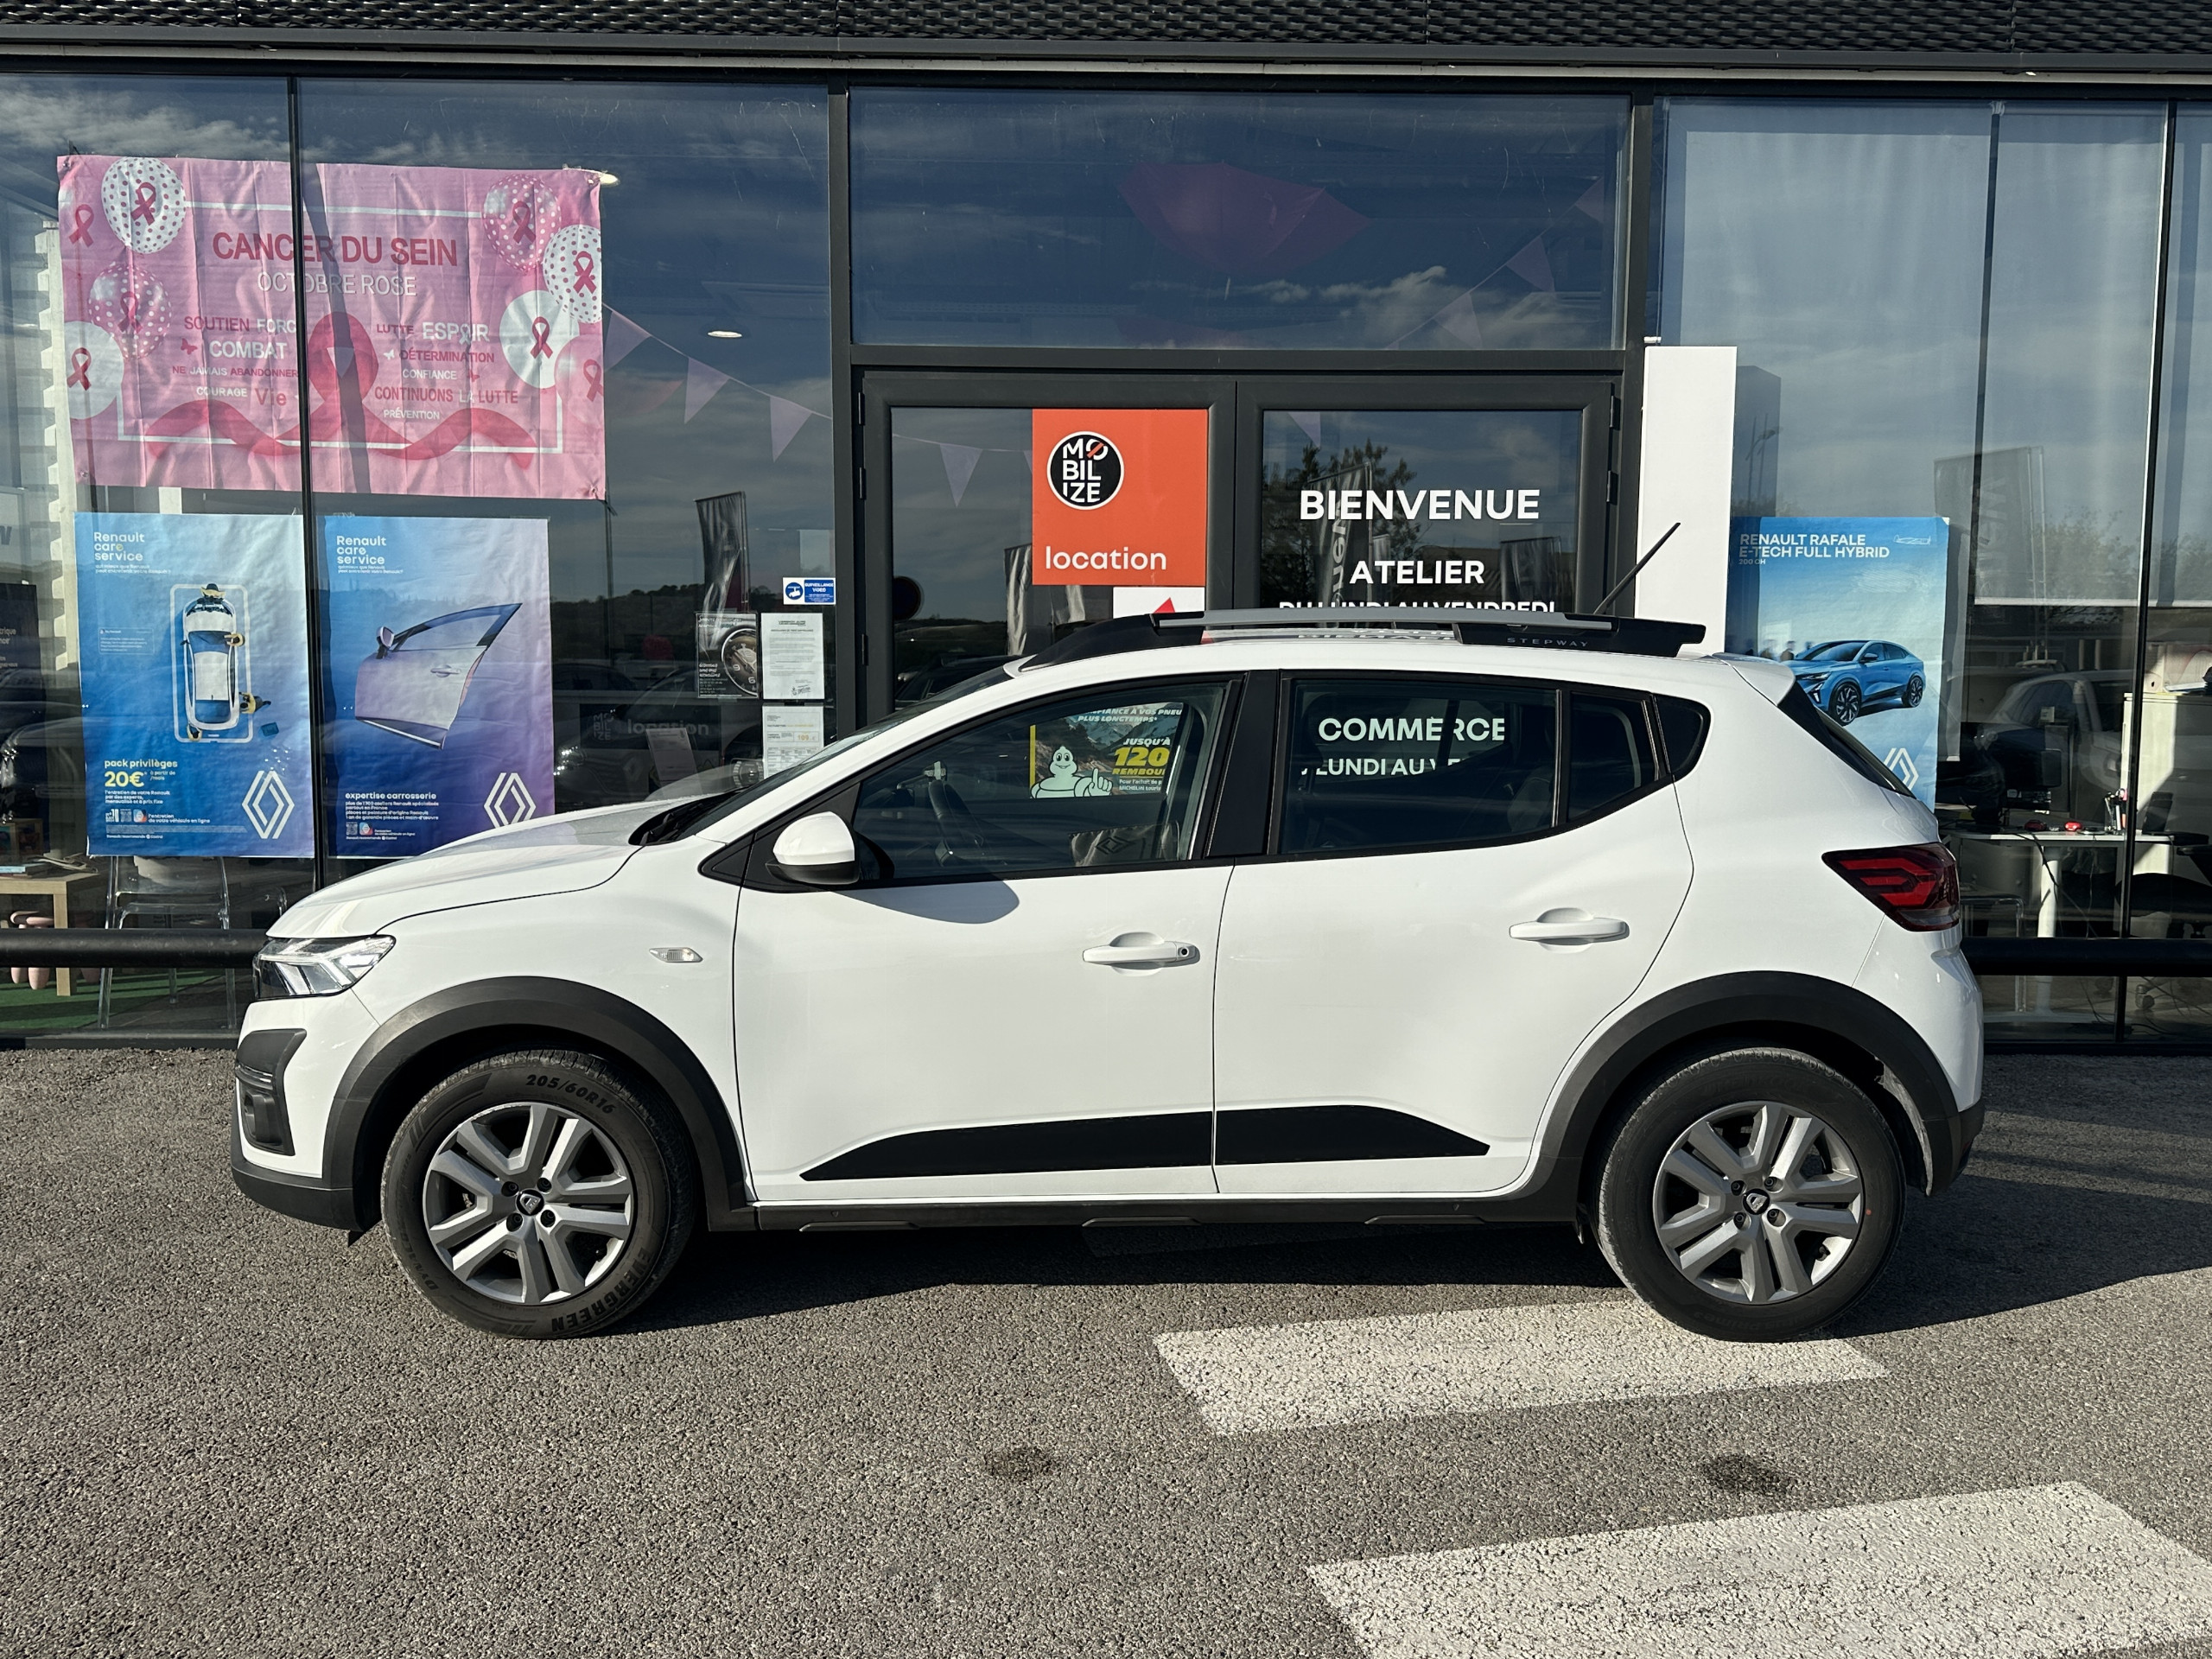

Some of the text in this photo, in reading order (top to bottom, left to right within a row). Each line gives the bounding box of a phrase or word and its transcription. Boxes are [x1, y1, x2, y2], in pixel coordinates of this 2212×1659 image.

[212, 232, 458, 266] CANCER DU SEIN
[257, 271, 416, 296] OCTOBRE ROSE
[184, 316, 296, 334] SOUTIEN FORC
[377, 321, 490, 345] LUTTE ESPOIR
[209, 340, 288, 359] COMBAT
[400, 347, 495, 363] DÉTERMINATION
[172, 365, 299, 378] NE JAMAIS ABANDONNER
[402, 369, 457, 379] CONFIANCE
[196, 386, 287, 406] COURAGE Vie
[374, 386, 518, 404] CONTINUONS LA LUTTE
[384, 407, 441, 420] PRÉVENTION
[1062, 460, 1102, 480] BIL
[1062, 482, 1101, 503] IZE
[1300, 489, 1541, 520] BIENVENUE
[93, 531, 145, 543] Renault
[336, 535, 387, 546] Renault
[1739, 534, 1866, 546] RENAULT RAFALE
[94, 543, 124, 551] care
[94, 550, 143, 562] service
[336, 546, 366, 555] care
[1738, 546, 1890, 558] E-TECH FULL HYBRID
[337, 554, 385, 565] service
[1046, 545, 1167, 570] location
[1349, 560, 1485, 584] ATELIER
[1507, 637, 1588, 647] STEPWAY
[1318, 717, 1505, 741] COMMERCE
[1123, 737, 1171, 747] JUSQU'À
[104, 759, 178, 770] pack privilèges
[1114, 747, 1170, 767] 120
[1391, 758, 1425, 776] AU
[345, 791, 385, 801] expertise
[525, 1073, 617, 1116] 205/60R16
[550, 1247, 648, 1332] EVERGREEN
